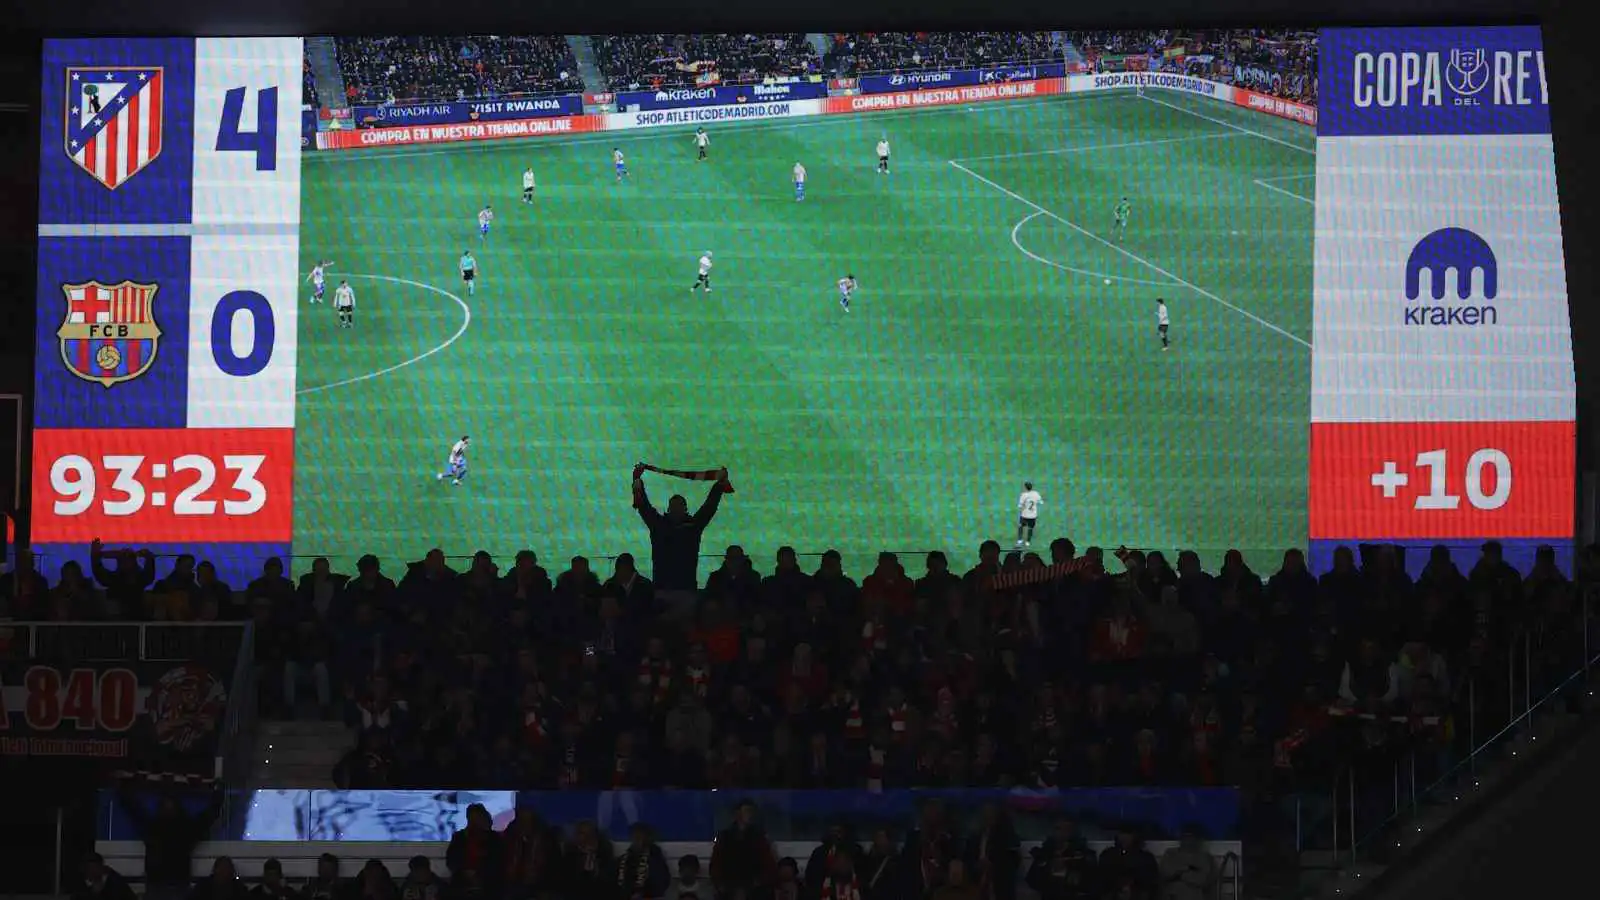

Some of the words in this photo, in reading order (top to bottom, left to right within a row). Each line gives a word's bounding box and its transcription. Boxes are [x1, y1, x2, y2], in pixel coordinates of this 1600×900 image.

[907, 72, 951, 84] HYUNDAI
[1354, 51, 1442, 107] COPA
[1454, 97, 1481, 106] DEL
[472, 102, 503, 113] VISIT
[506, 99, 560, 112] RWANDA
[852, 94, 895, 109] COMPRA
[896, 93, 911, 105] EN
[912, 89, 960, 104] NUESTRA
[961, 86, 997, 99] TIENDA
[997, 82, 1036, 96] ONLINE
[389, 105, 430, 118] RIYADH
[433, 104, 451, 115] AIR
[636, 103, 790, 126] SHOP.ATLETICODEMADRID.COM
[215, 86, 278, 171] 4
[361, 127, 411, 143] COMPRA
[414, 126, 429, 140] EN
[431, 124, 485, 140] NUESTRA
[486, 121, 528, 135] TIENDA
[528, 118, 573, 132] ONLINE
[1405, 305, 1497, 326] kraken
[89, 325, 129, 337] FCB
[211, 290, 275, 377] 0
[50, 454, 267, 515] 93:23
[1371, 448, 1512, 510] +10
[24, 665, 138, 732] 840
